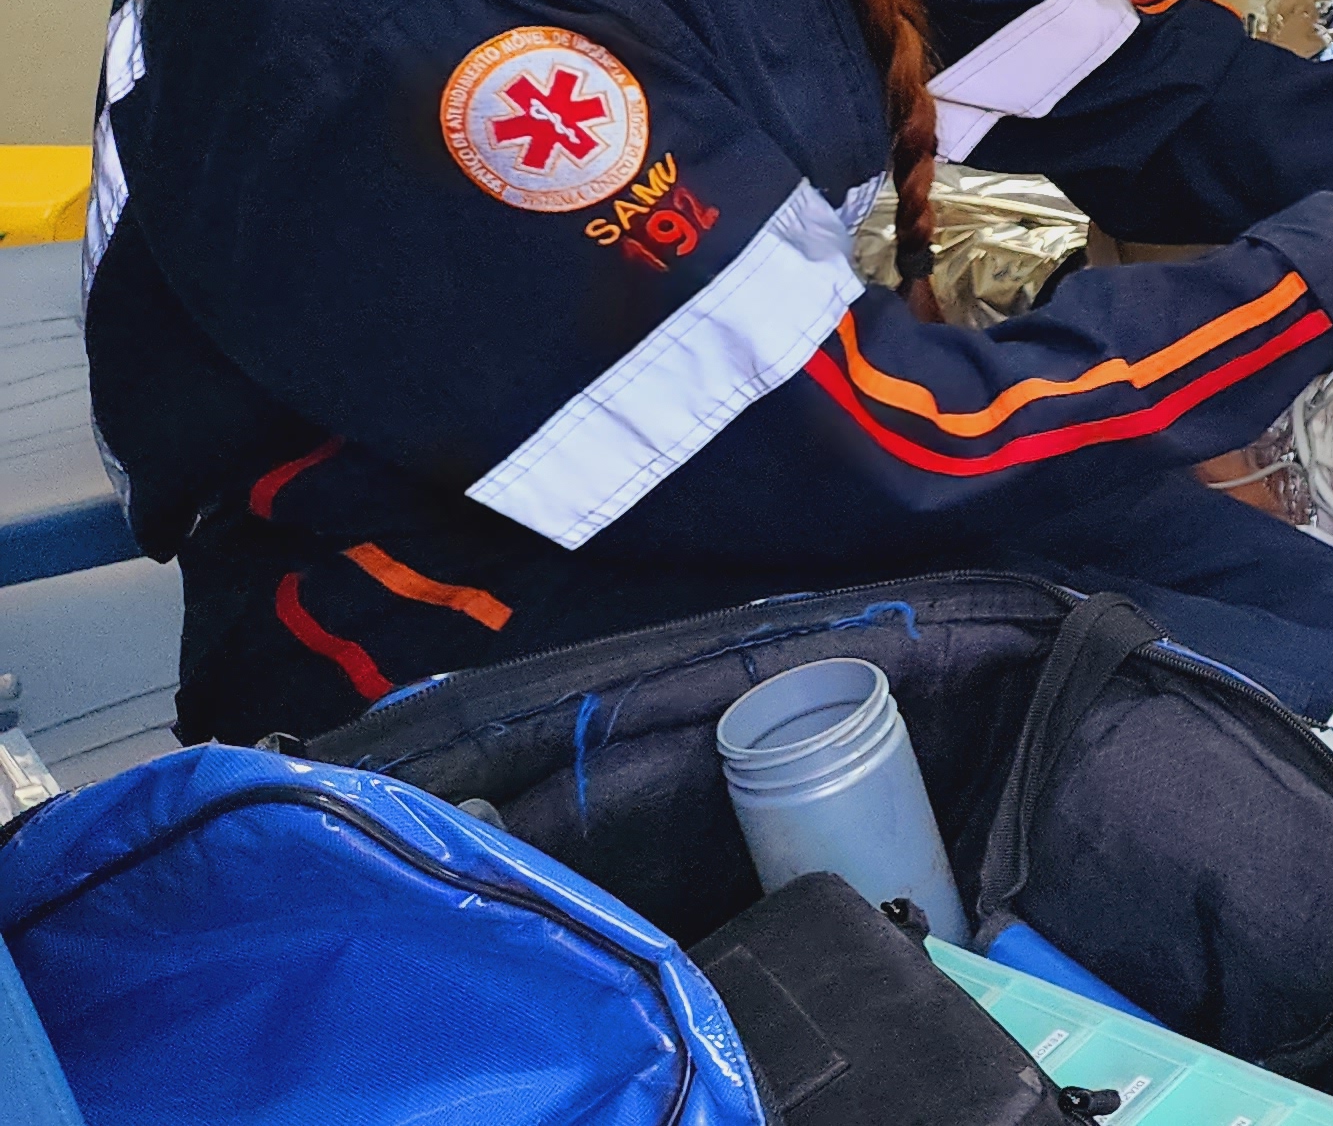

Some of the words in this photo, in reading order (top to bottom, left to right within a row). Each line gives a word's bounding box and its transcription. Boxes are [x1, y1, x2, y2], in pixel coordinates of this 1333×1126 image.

[446, 46, 501, 128] ATENDIMENTO
[502, 30, 550, 54] MÓVEL
[551, 33, 571, 46] DE
[585, 152, 677, 245] SAMU
[622, 187, 719, 271] 192
